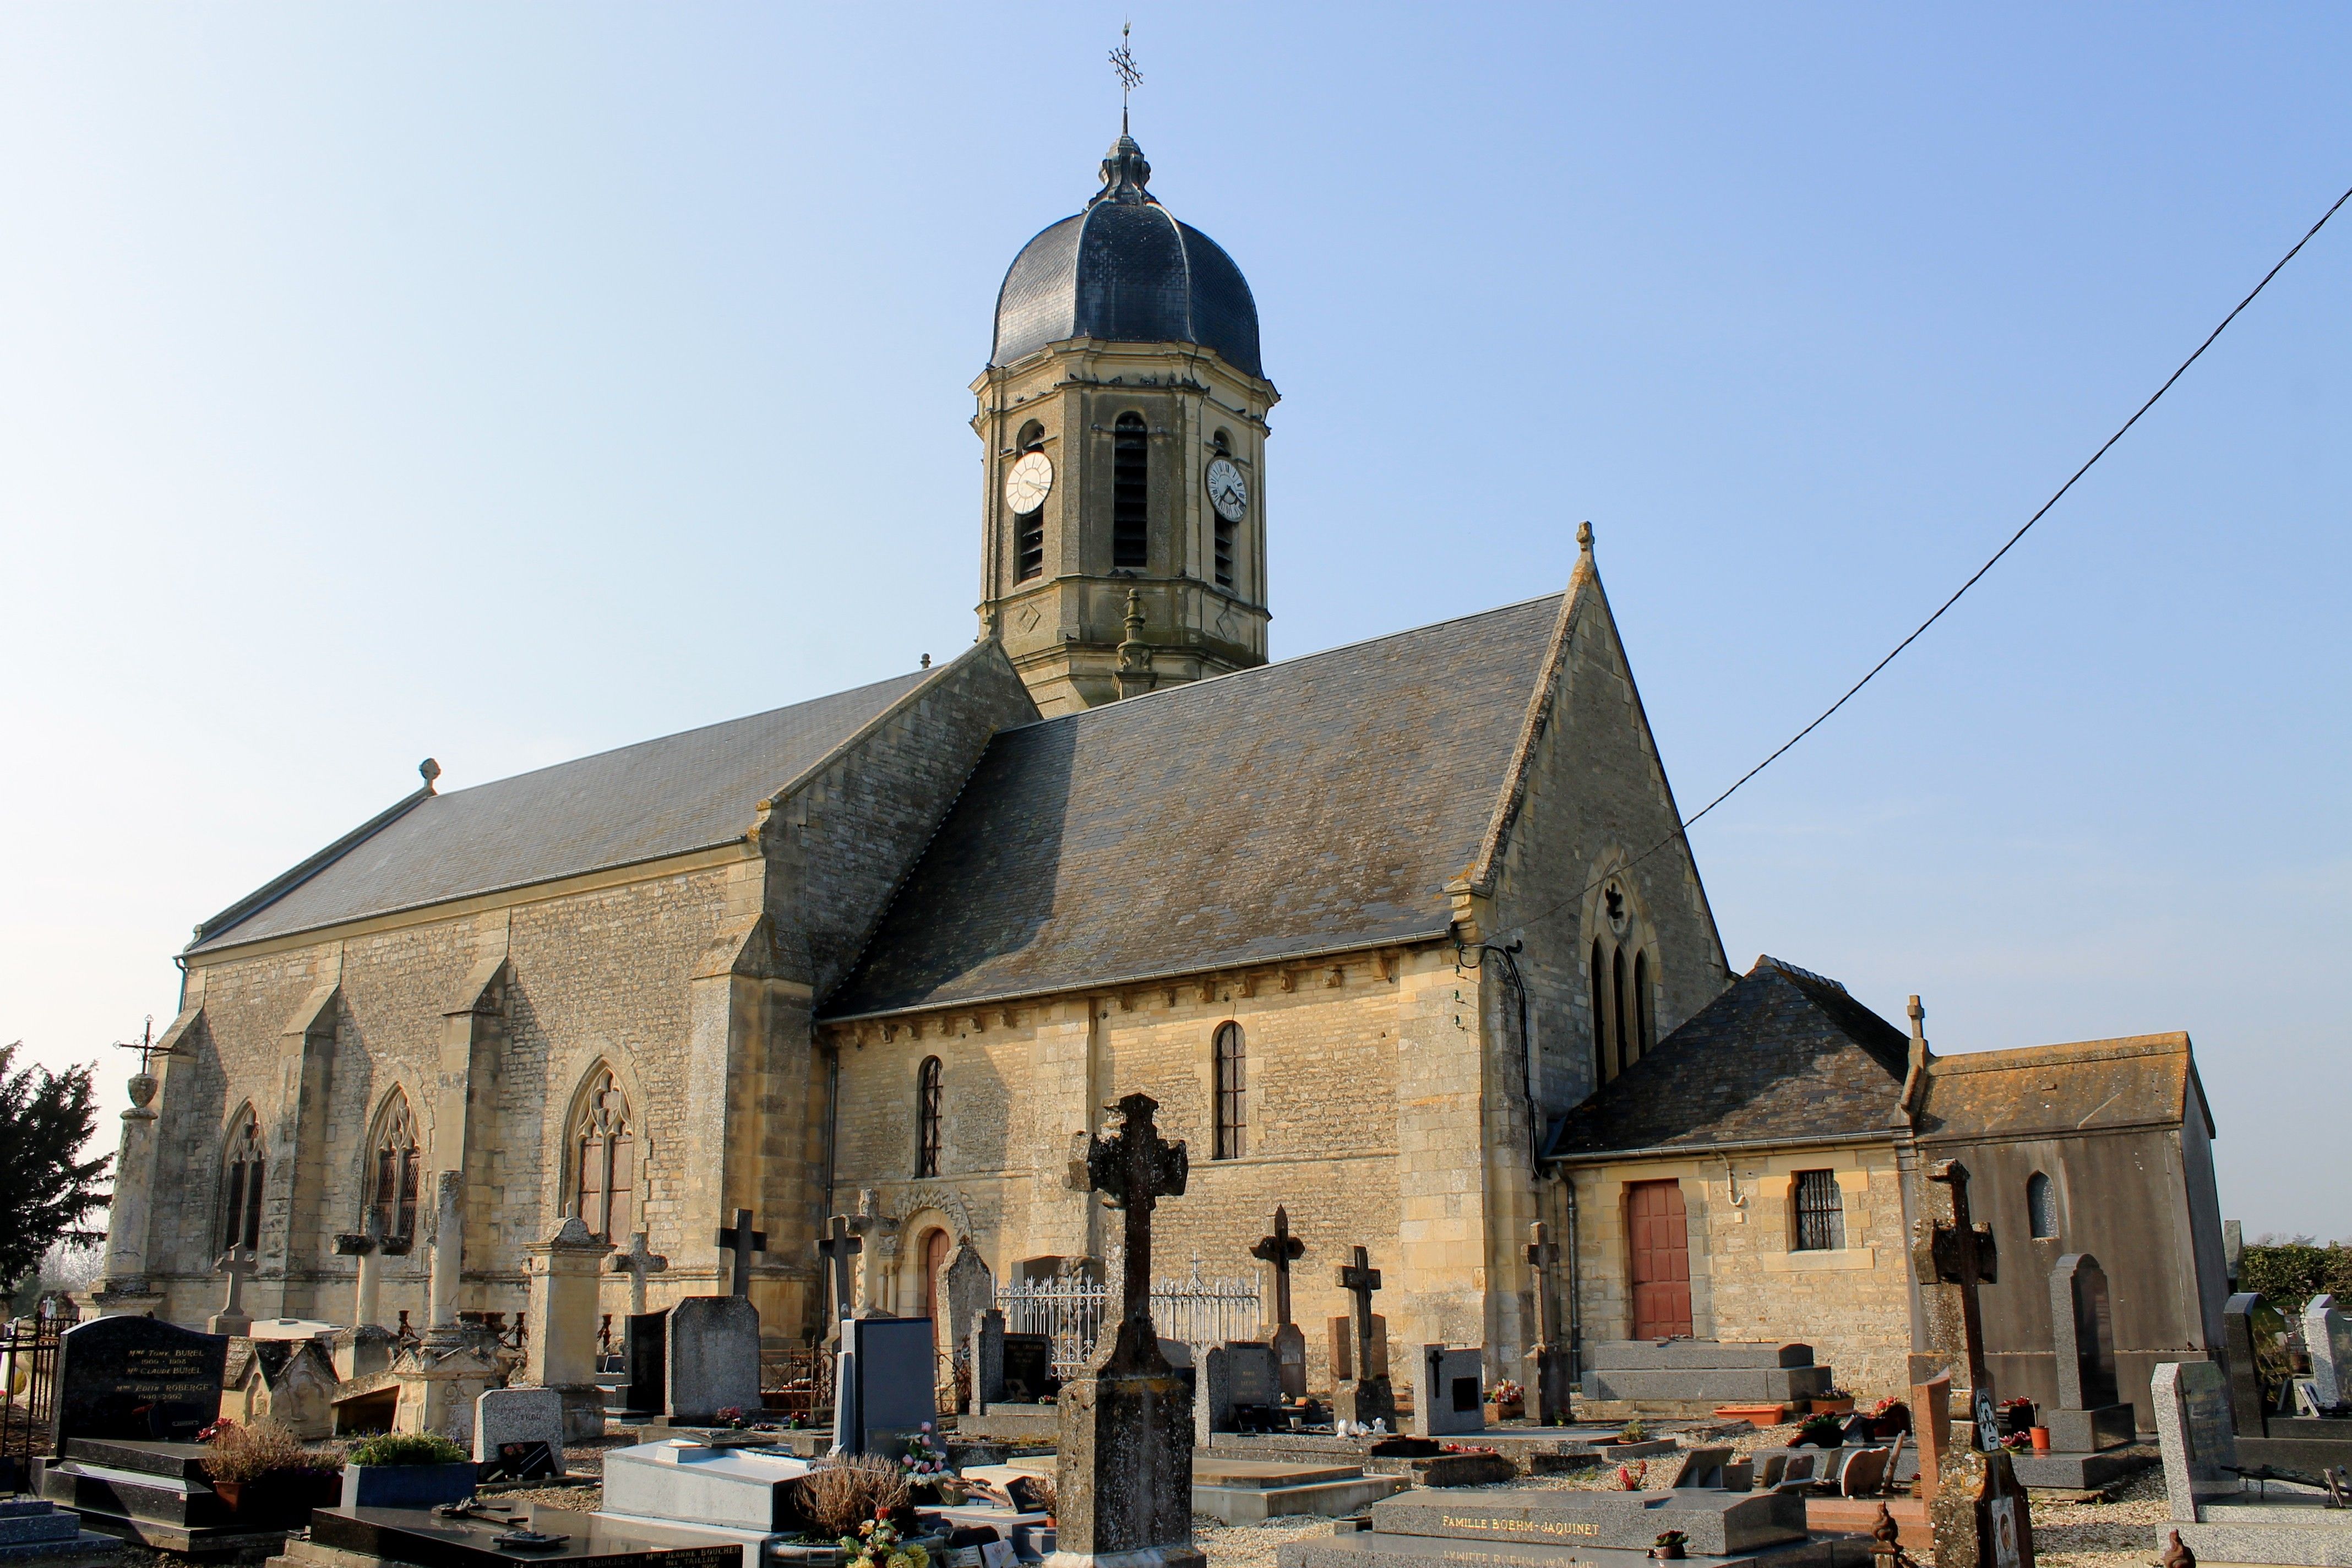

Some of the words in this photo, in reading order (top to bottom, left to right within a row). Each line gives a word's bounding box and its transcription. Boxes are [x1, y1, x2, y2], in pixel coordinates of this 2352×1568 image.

[165, 1384, 210, 1392] ROBERGE
[1442, 1515, 1488, 1529] FAMILLE
[1492, 1518, 1600, 1536] BOEHM-JAQUINET
[665, 1551, 696, 1559] JEANNE
[700, 1546, 740, 1557] BOUCHER
[587, 1557, 633, 1567] BOUCHER
